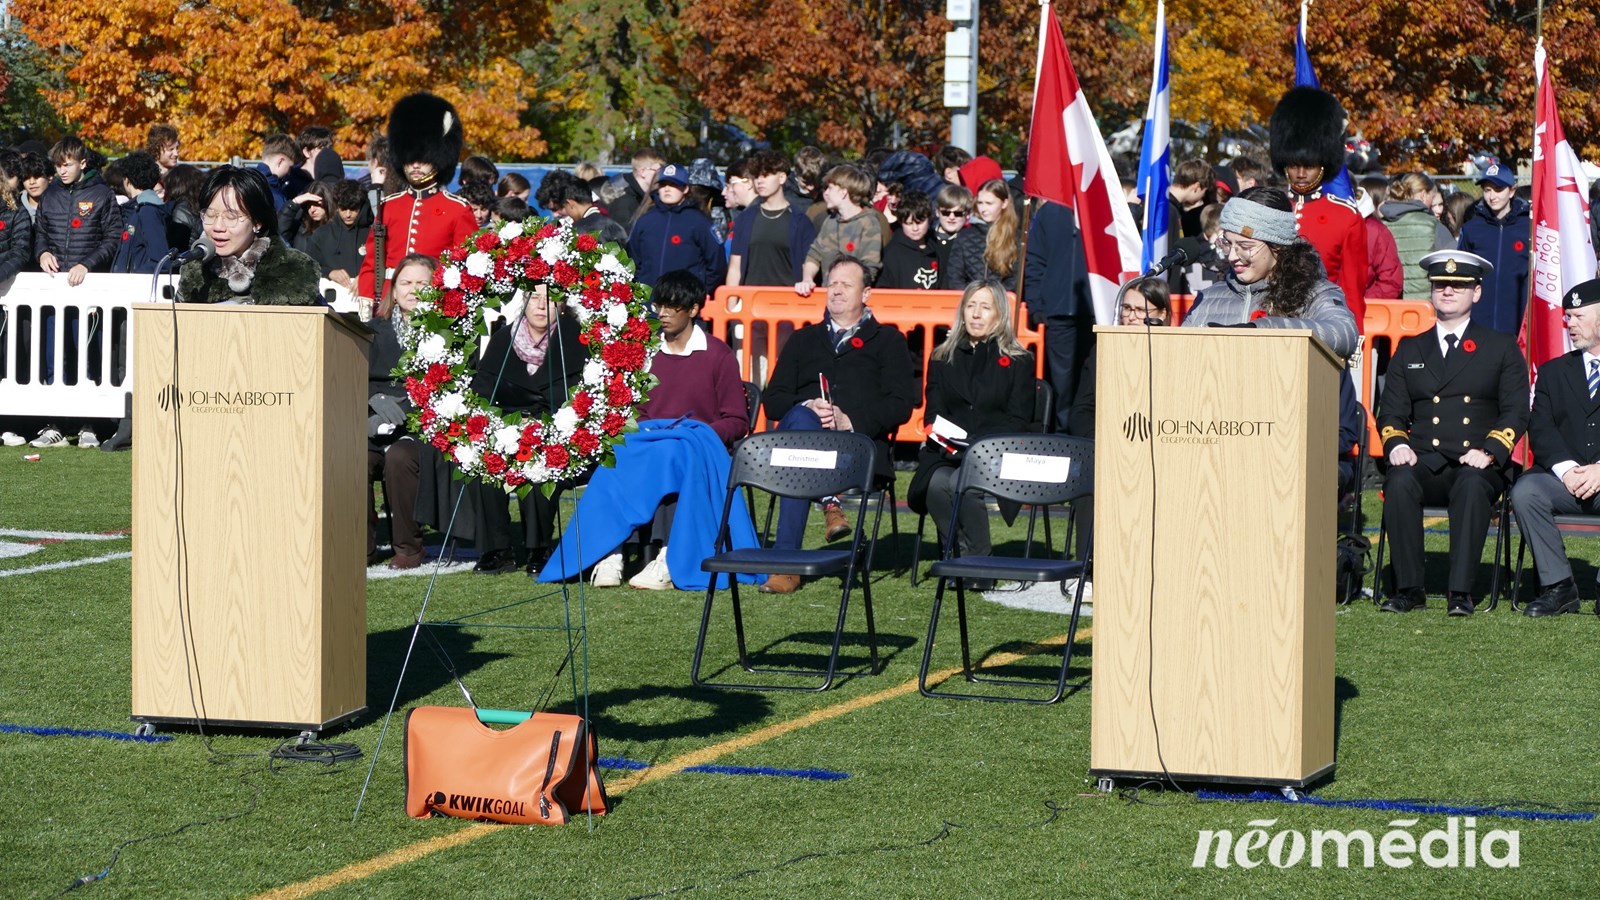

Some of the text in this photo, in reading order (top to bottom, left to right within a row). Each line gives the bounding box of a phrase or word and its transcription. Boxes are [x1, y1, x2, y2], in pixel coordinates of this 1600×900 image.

[188, 390, 295, 406] JOHN ABBOTT
[1157, 419, 1275, 437] JOHN ABBOTT
[787, 454, 819, 463] Christine
[1025, 456, 1046, 465] Maya
